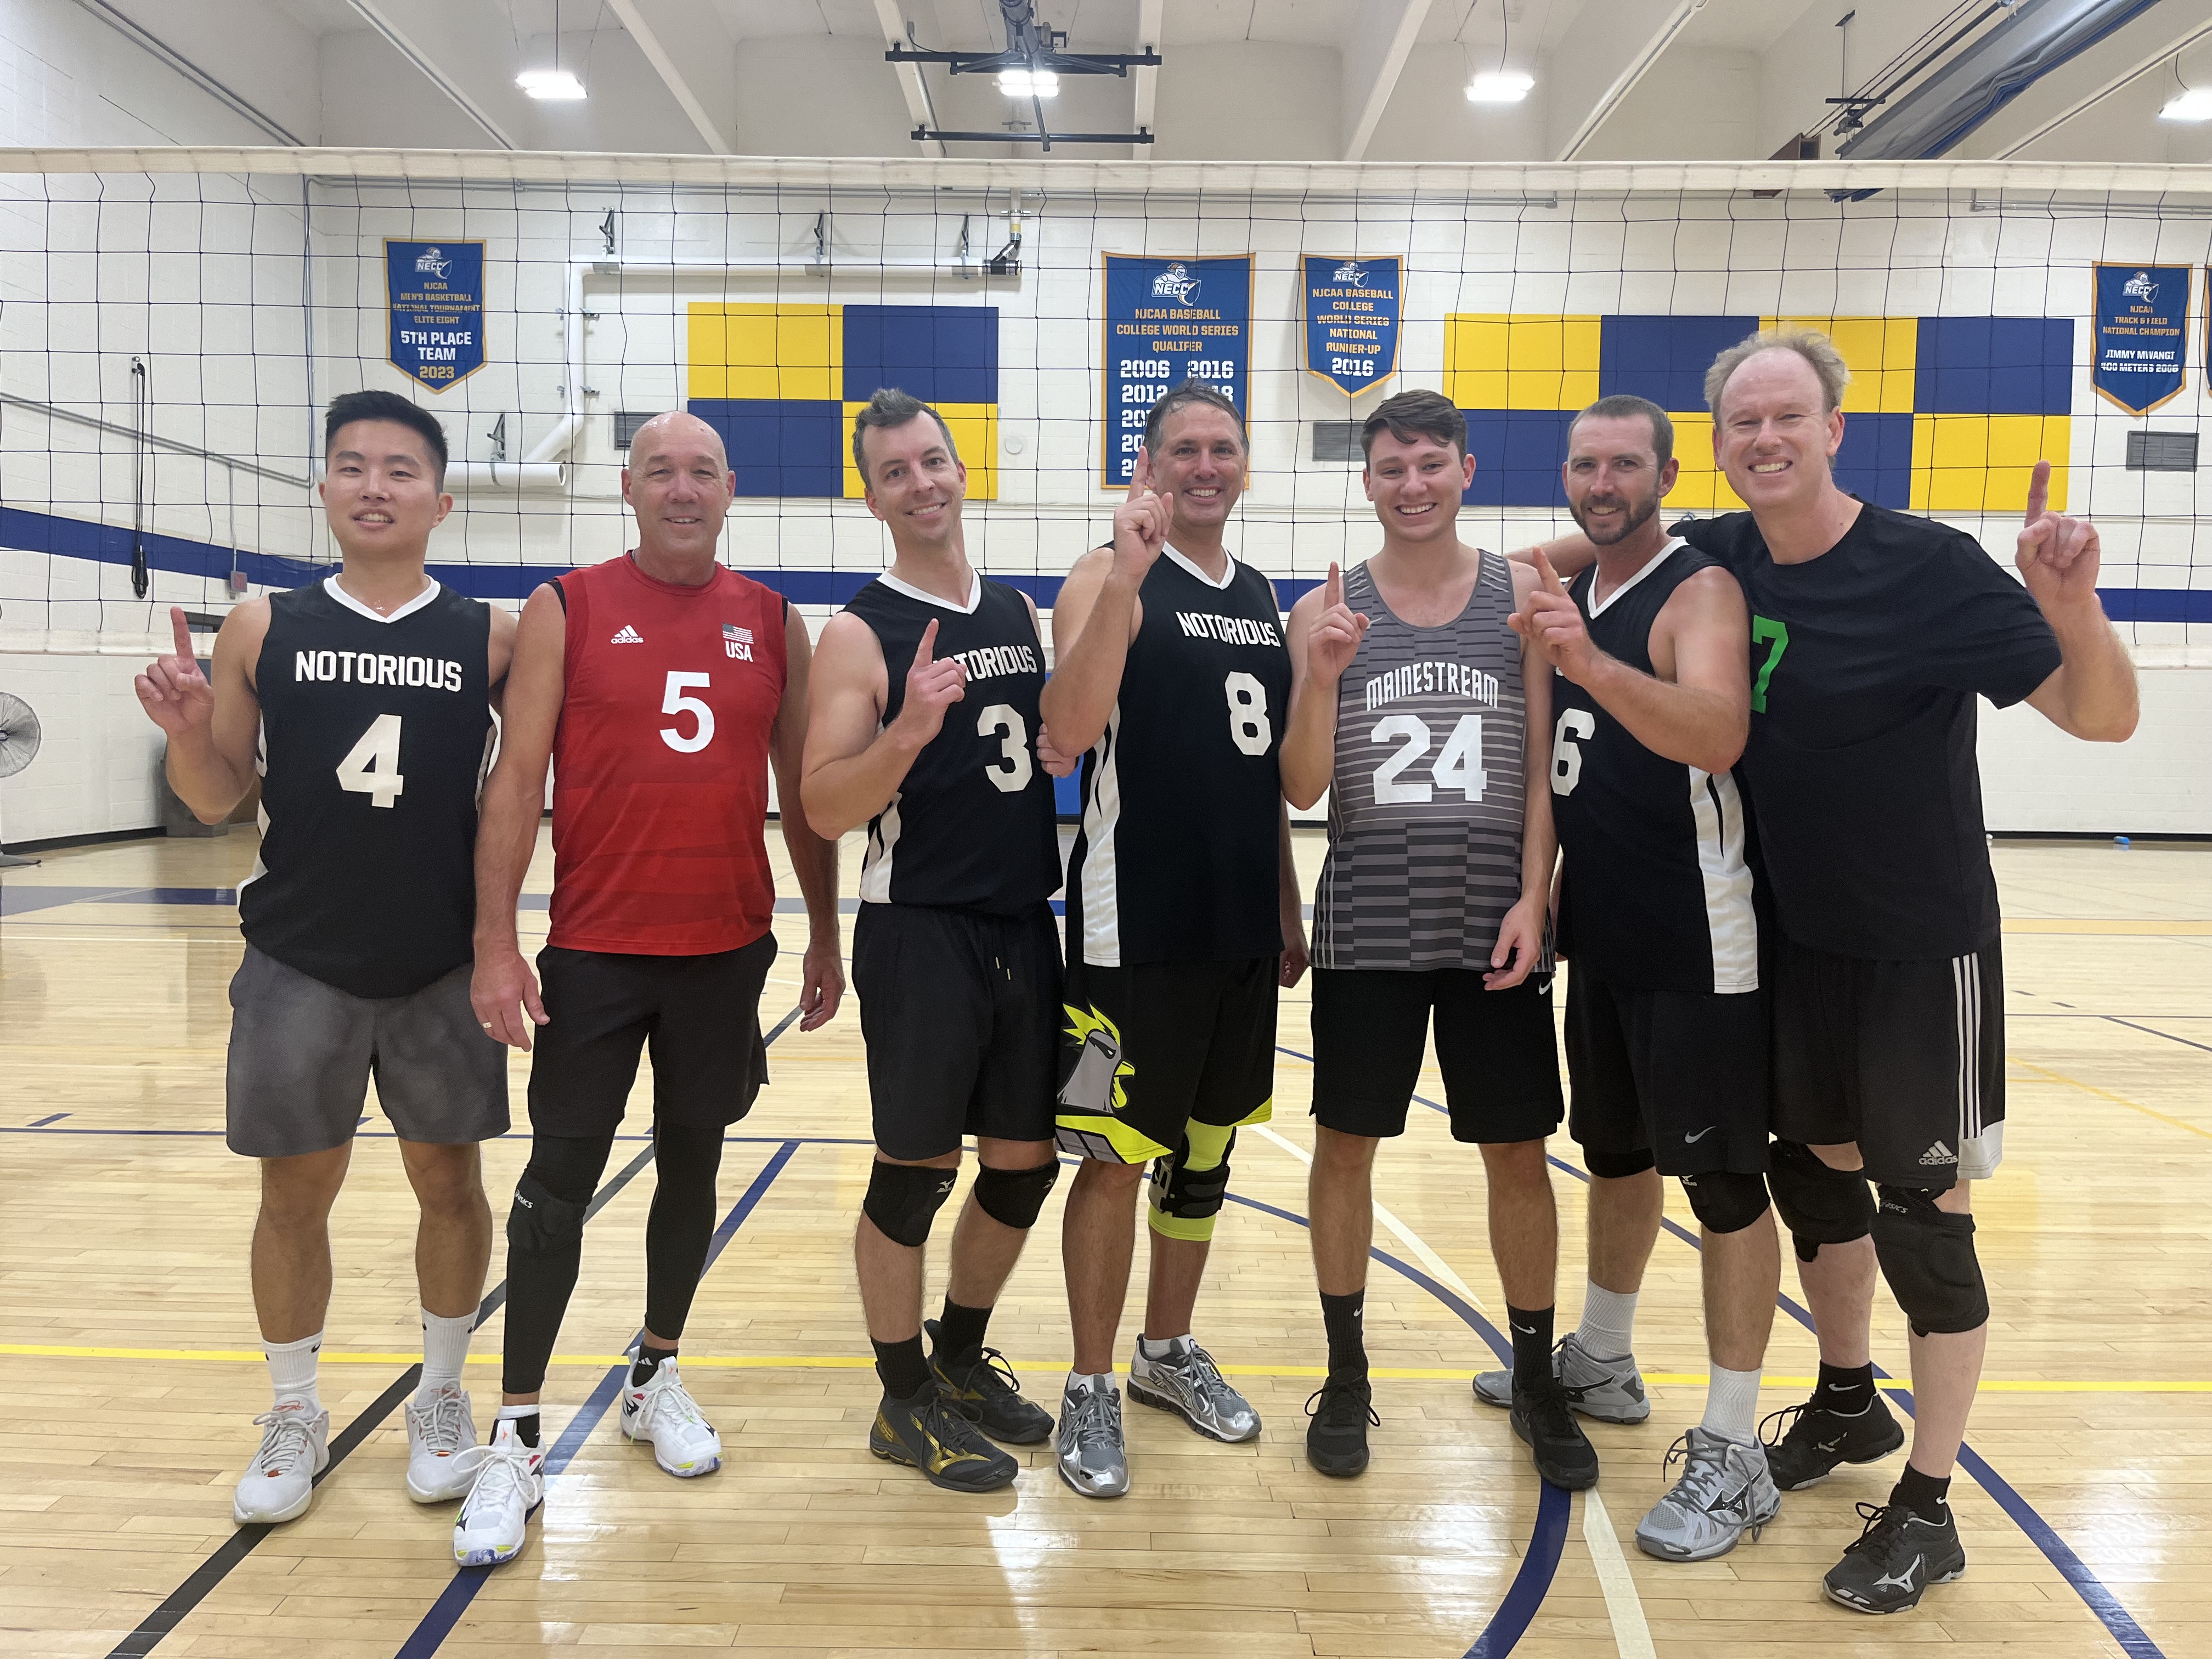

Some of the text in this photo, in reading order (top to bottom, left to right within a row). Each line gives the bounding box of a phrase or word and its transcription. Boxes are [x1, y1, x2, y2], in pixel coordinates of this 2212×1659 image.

[417, 262, 442, 271] NECC
[424, 282, 448, 290] NJCAA
[1155, 283, 1188, 295] NECC
[2125, 286, 2149, 295] NECC
[425, 294, 472, 302] BASKETBALL
[1312, 289, 1393, 300] NJCAA BASEBALL
[1333, 301, 1374, 312] COLLEGE
[414, 315, 460, 324] ELITE EIGHT
[1135, 308, 1221, 319] NJCAA BASEBALL
[1317, 315, 1390, 326] WORLD SERIES
[1116, 324, 1239, 336] COLLEGE WORLD SERIES
[1330, 328, 1378, 340] NATIONAL
[2103, 325, 2180, 336] NATIONAL CHAMPION
[400, 331, 472, 345] 5TH PLACE
[417, 347, 456, 360] TEAM
[1326, 342, 1381, 354] RUNNER-UP
[2105, 349, 2175, 360] JIMMY MWANGI
[419, 366, 455, 379] 2023
[1120, 360, 1234, 379] 2006 2016
[1331, 357, 1374, 377] 2016
[2101, 362, 2118, 371] 400
[2119, 363, 2154, 373] METERS
[1175, 611, 1281, 647] NOTORIOUS
[725, 641, 754, 663] USA
[933, 645, 1038, 682] TORIOUS
[1750, 614, 1789, 714] 7
[295, 650, 462, 692] NOTORIOUS
[1366, 661, 1499, 712] MAINESTREAM
[659, 670, 715, 753] 5
[1224, 671, 1272, 756] 8
[977, 703, 1033, 793] 3
[1550, 708, 1595, 797] 6
[336, 714, 404, 808] 4
[1371, 714, 1487, 805] 24
[1918, 1155, 1959, 1165] adidas
